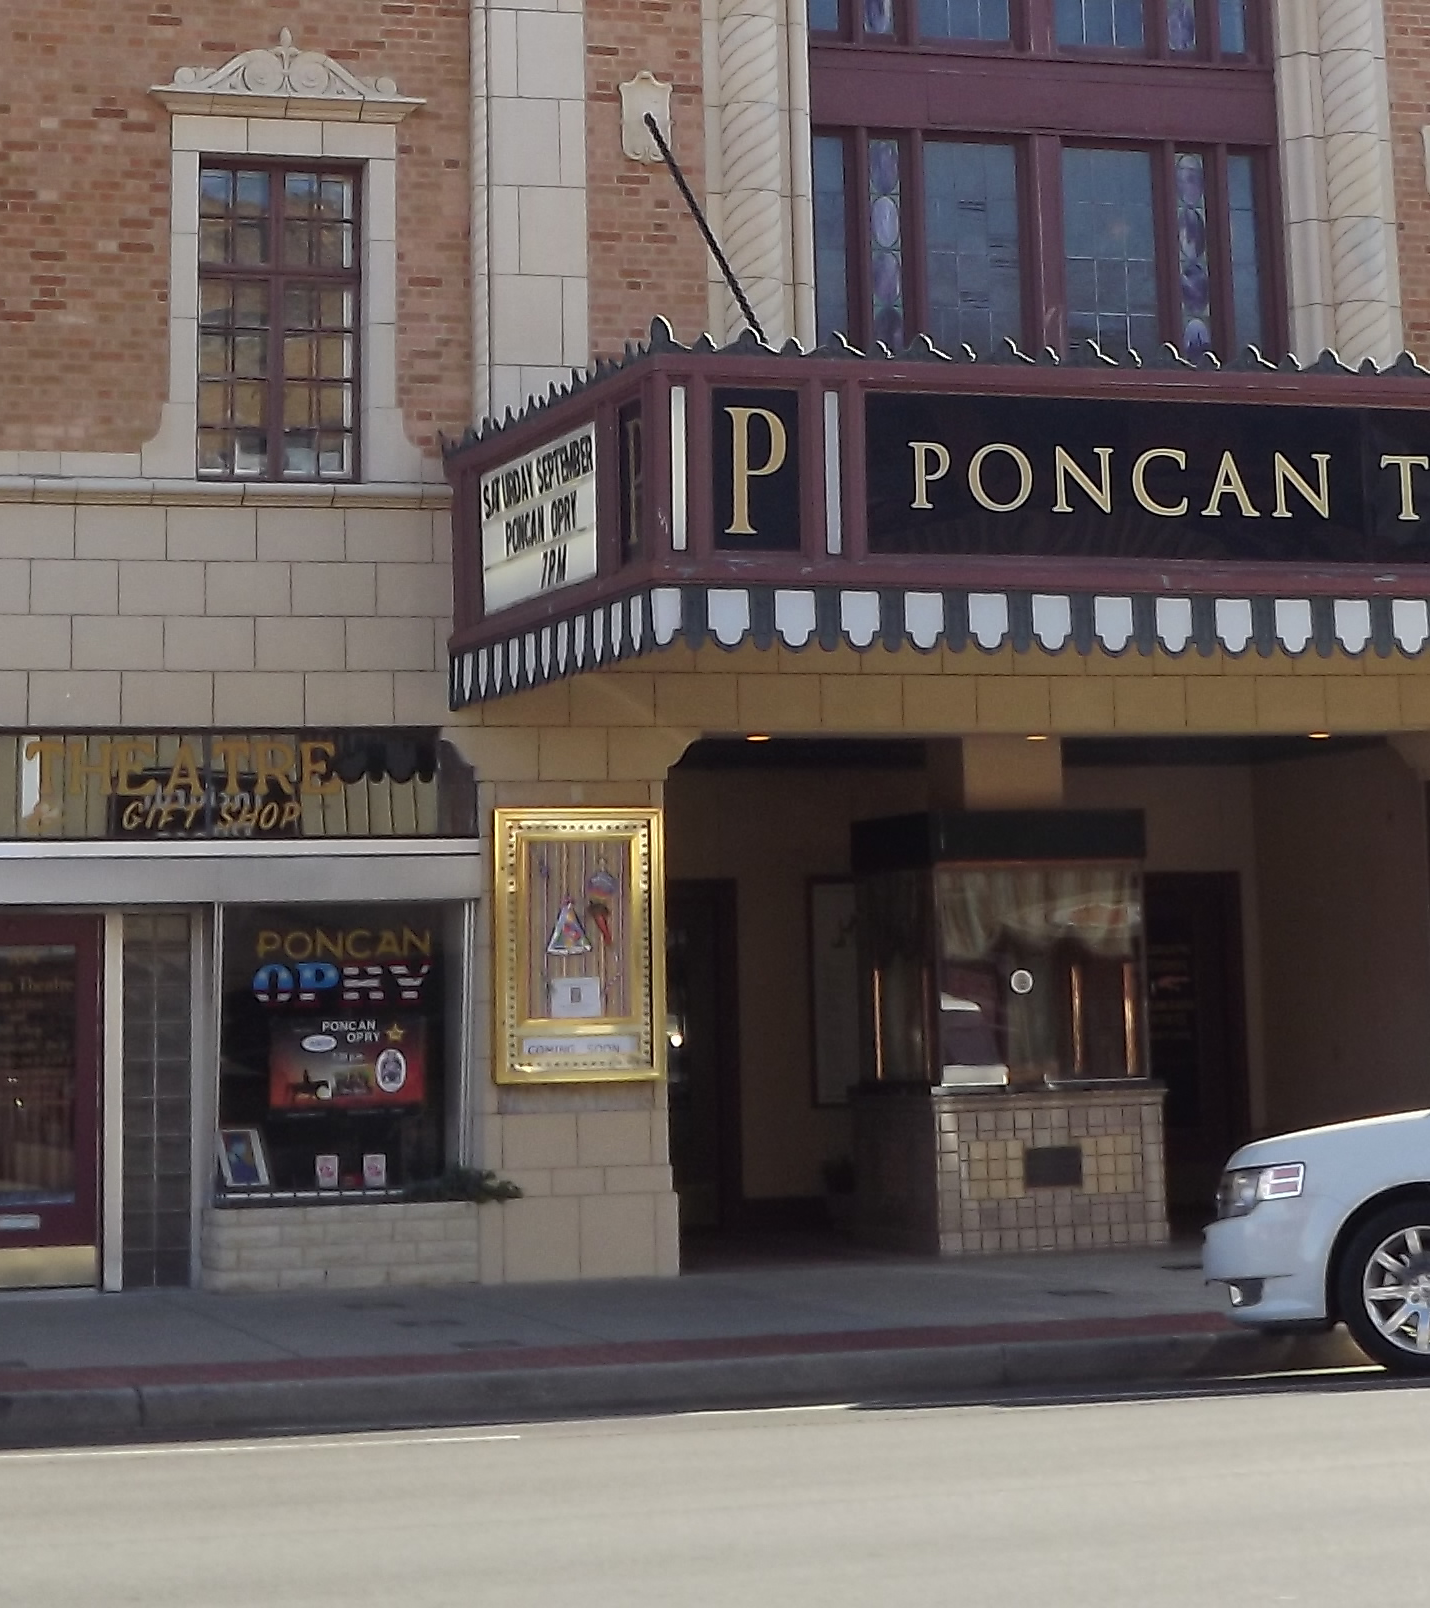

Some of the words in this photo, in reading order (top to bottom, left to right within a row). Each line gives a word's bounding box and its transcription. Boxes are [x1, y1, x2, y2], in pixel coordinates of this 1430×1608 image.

[483, 461, 534, 519] SATURDAY
[536, 435, 594, 493] SEPTEMBER
[724, 406, 787, 535] P
[907, 441, 1332, 520] PONCAN
[505, 505, 545, 557] PONCAN
[551, 490, 577, 538] OPRY
[541, 543, 568, 589] 7PM
[25, 741, 343, 797] THEATRE
[123, 801, 204, 830] GIFT
[219, 801, 302, 831] SHOP
[256, 928, 432, 960] PONCAN
[252, 962, 432, 1005] OPRY
[322, 1020, 376, 1032] PONCAN
[346, 1031, 380, 1043] OPRY
[528, 1044, 575, 1055] COMING
[586, 1043, 620, 1054] SOON
